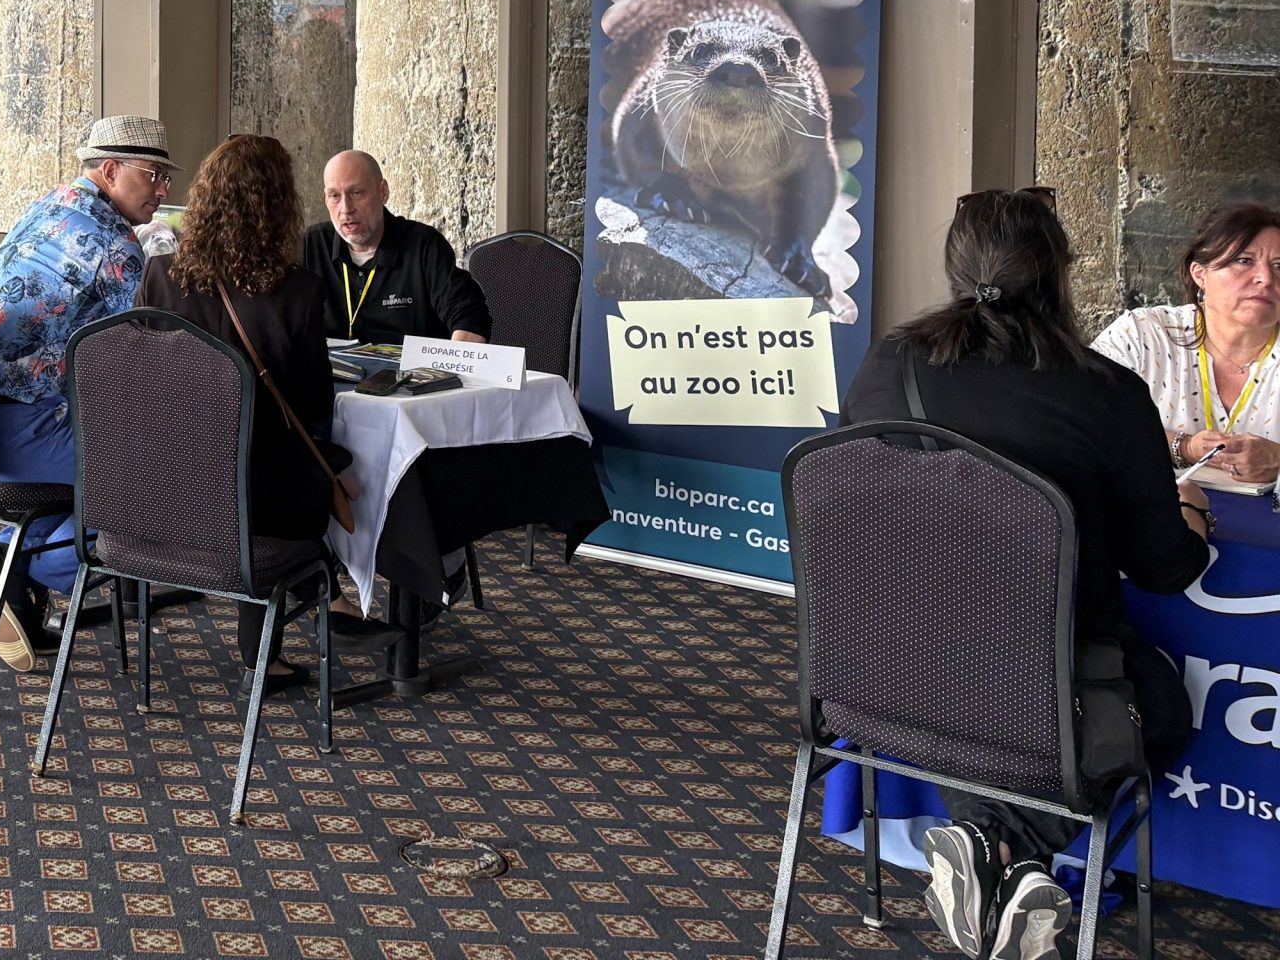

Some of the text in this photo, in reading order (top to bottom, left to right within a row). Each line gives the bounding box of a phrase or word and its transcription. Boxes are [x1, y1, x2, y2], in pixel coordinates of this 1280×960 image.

[624, 324, 815, 354] On n'est pas
[421, 346, 489, 361] BIOPARC DE LA
[431, 359, 475, 374] GASPÉSIE
[506, 375, 513, 383] 6
[640, 369, 796, 396] au zoo ici!
[655, 478, 775, 517] bioparc.ca
[610, 509, 722, 541] naventure
[1156, 646, 1280, 749] ra
